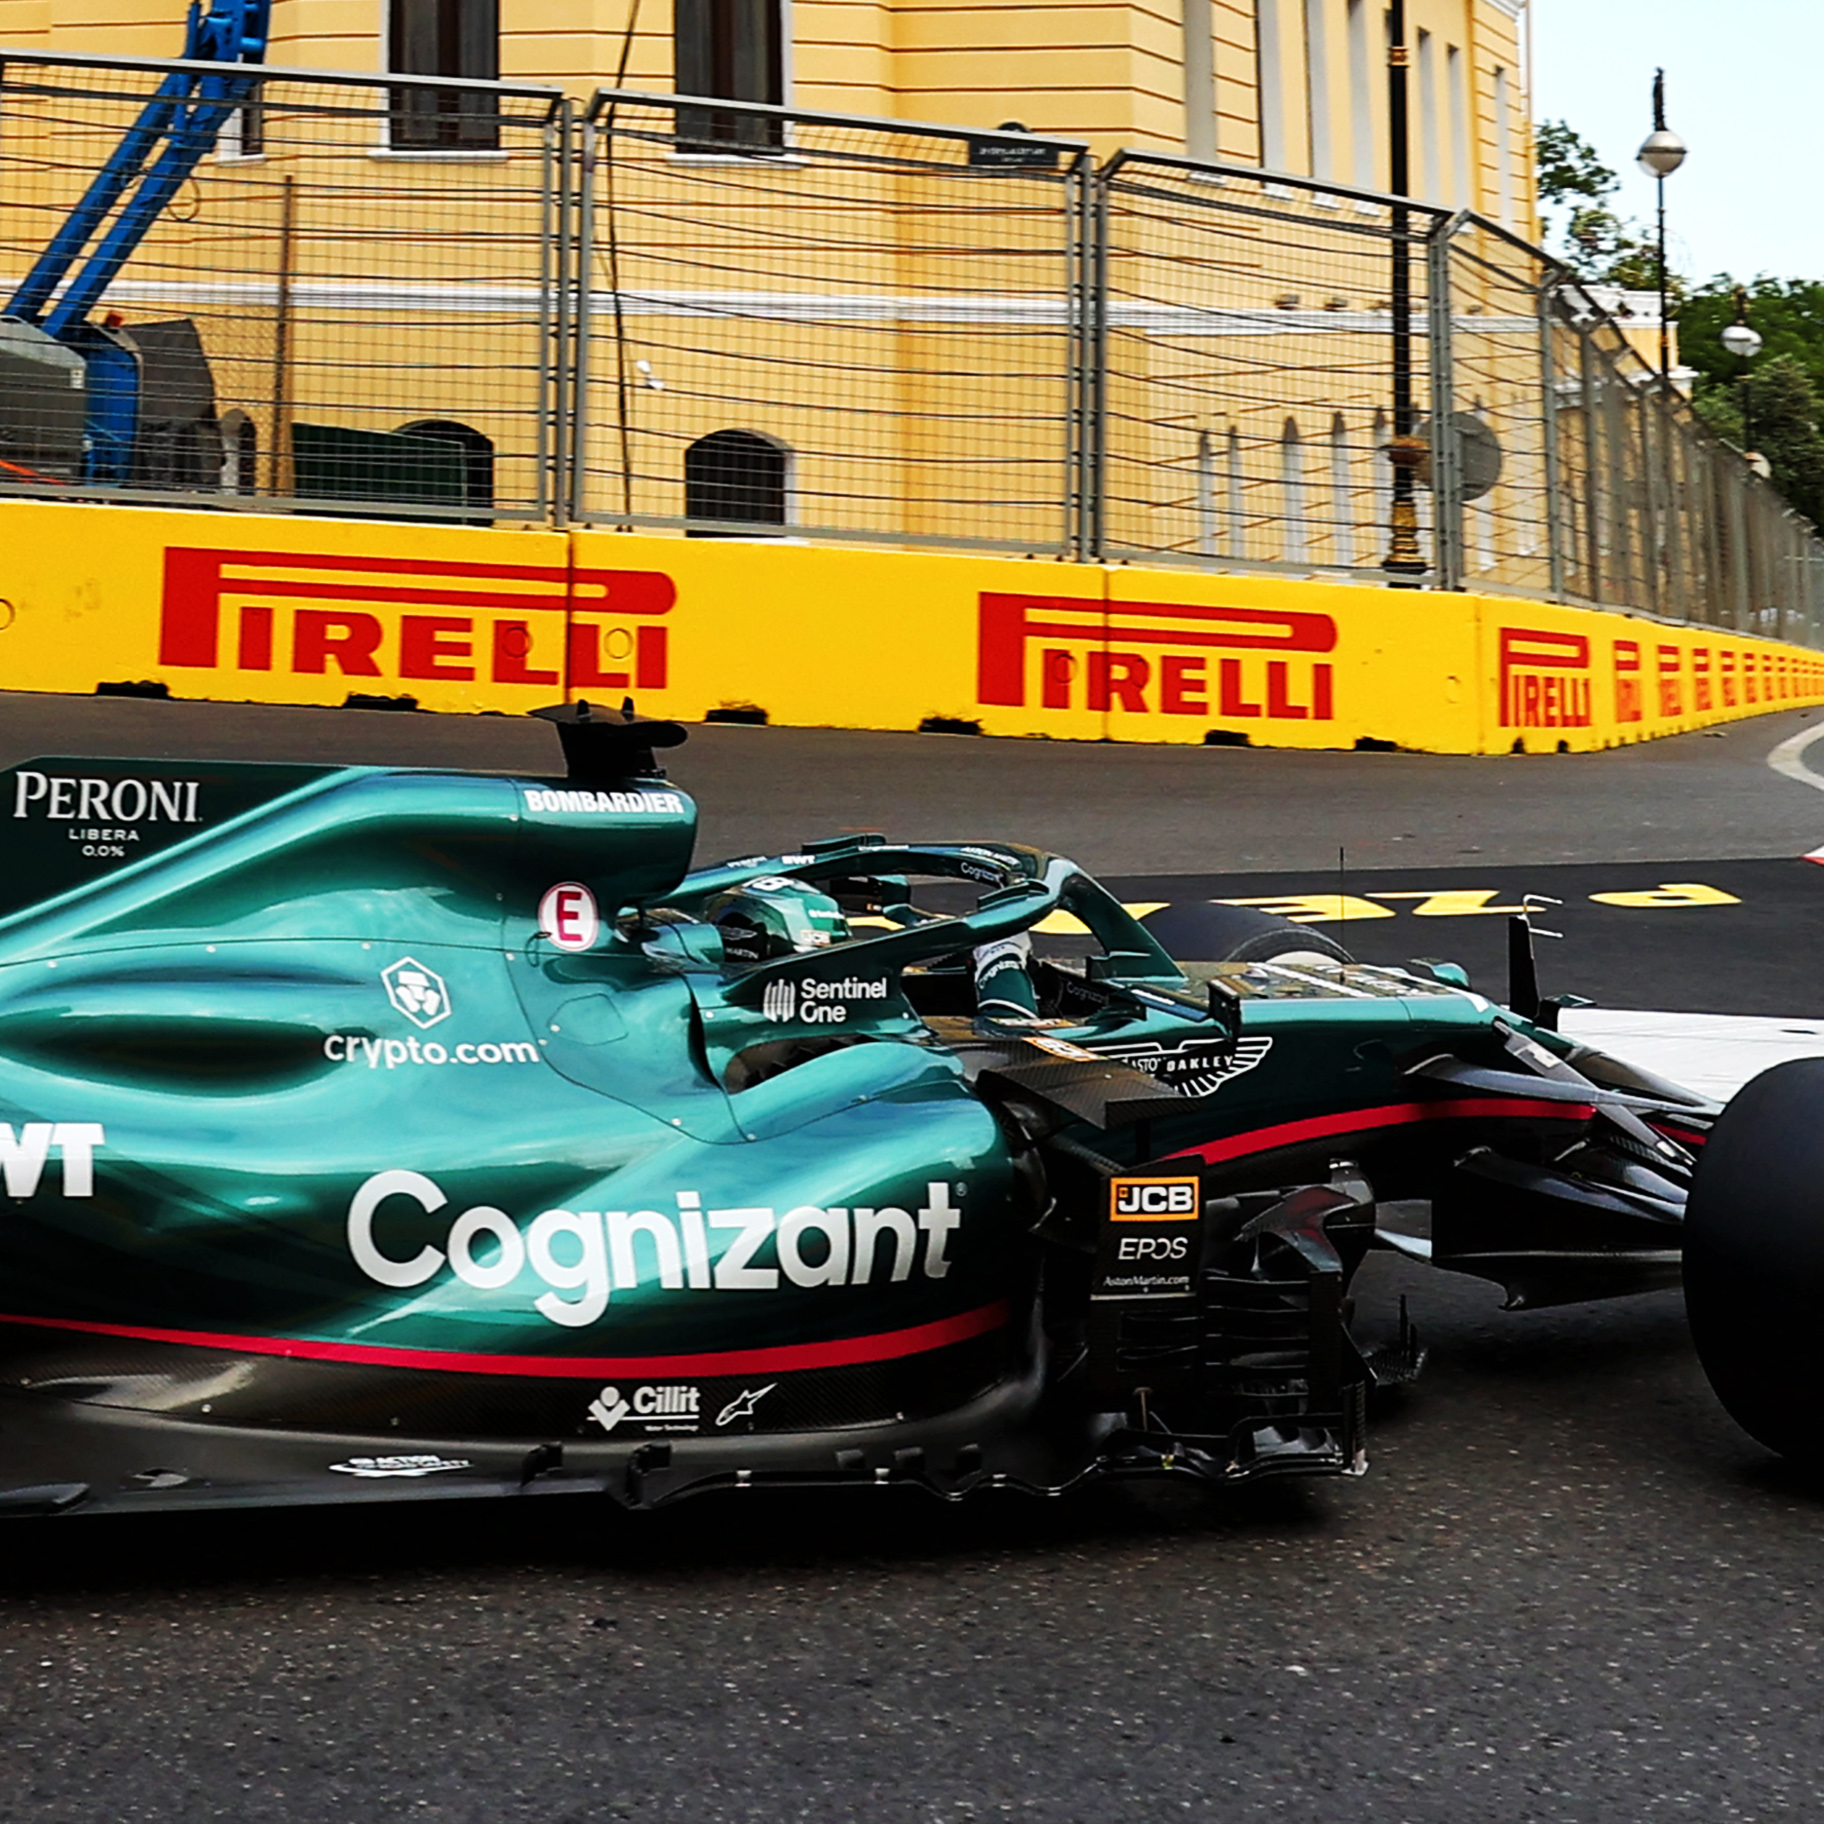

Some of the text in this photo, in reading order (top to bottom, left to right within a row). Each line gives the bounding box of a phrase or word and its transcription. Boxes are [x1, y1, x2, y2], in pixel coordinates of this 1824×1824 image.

[159, 546, 677, 690] PIRELLI
[977, 592, 1337, 720] PIRELLI
[1500, 627, 1590, 727] PIRELLI
[13, 771, 201, 822] PERONI
[524, 789, 684, 814] BOMBARDIER
[68, 829, 140, 841] LIBERA
[82, 845, 125, 858] 0.0%
[556, 890, 582, 943] E
[800, 977, 888, 1000] Sentinel
[799, 1002, 846, 1023] One
[323, 1033, 540, 1070] crypto.com
[1166, 1056, 1234, 1072] OAKLEY
[1118, 1186, 1193, 1212] JCB
[348, 1169, 961, 1327] Cognizant
[1118, 1236, 1188, 1260] EPOS
[634, 1386, 700, 1413] Cillit
